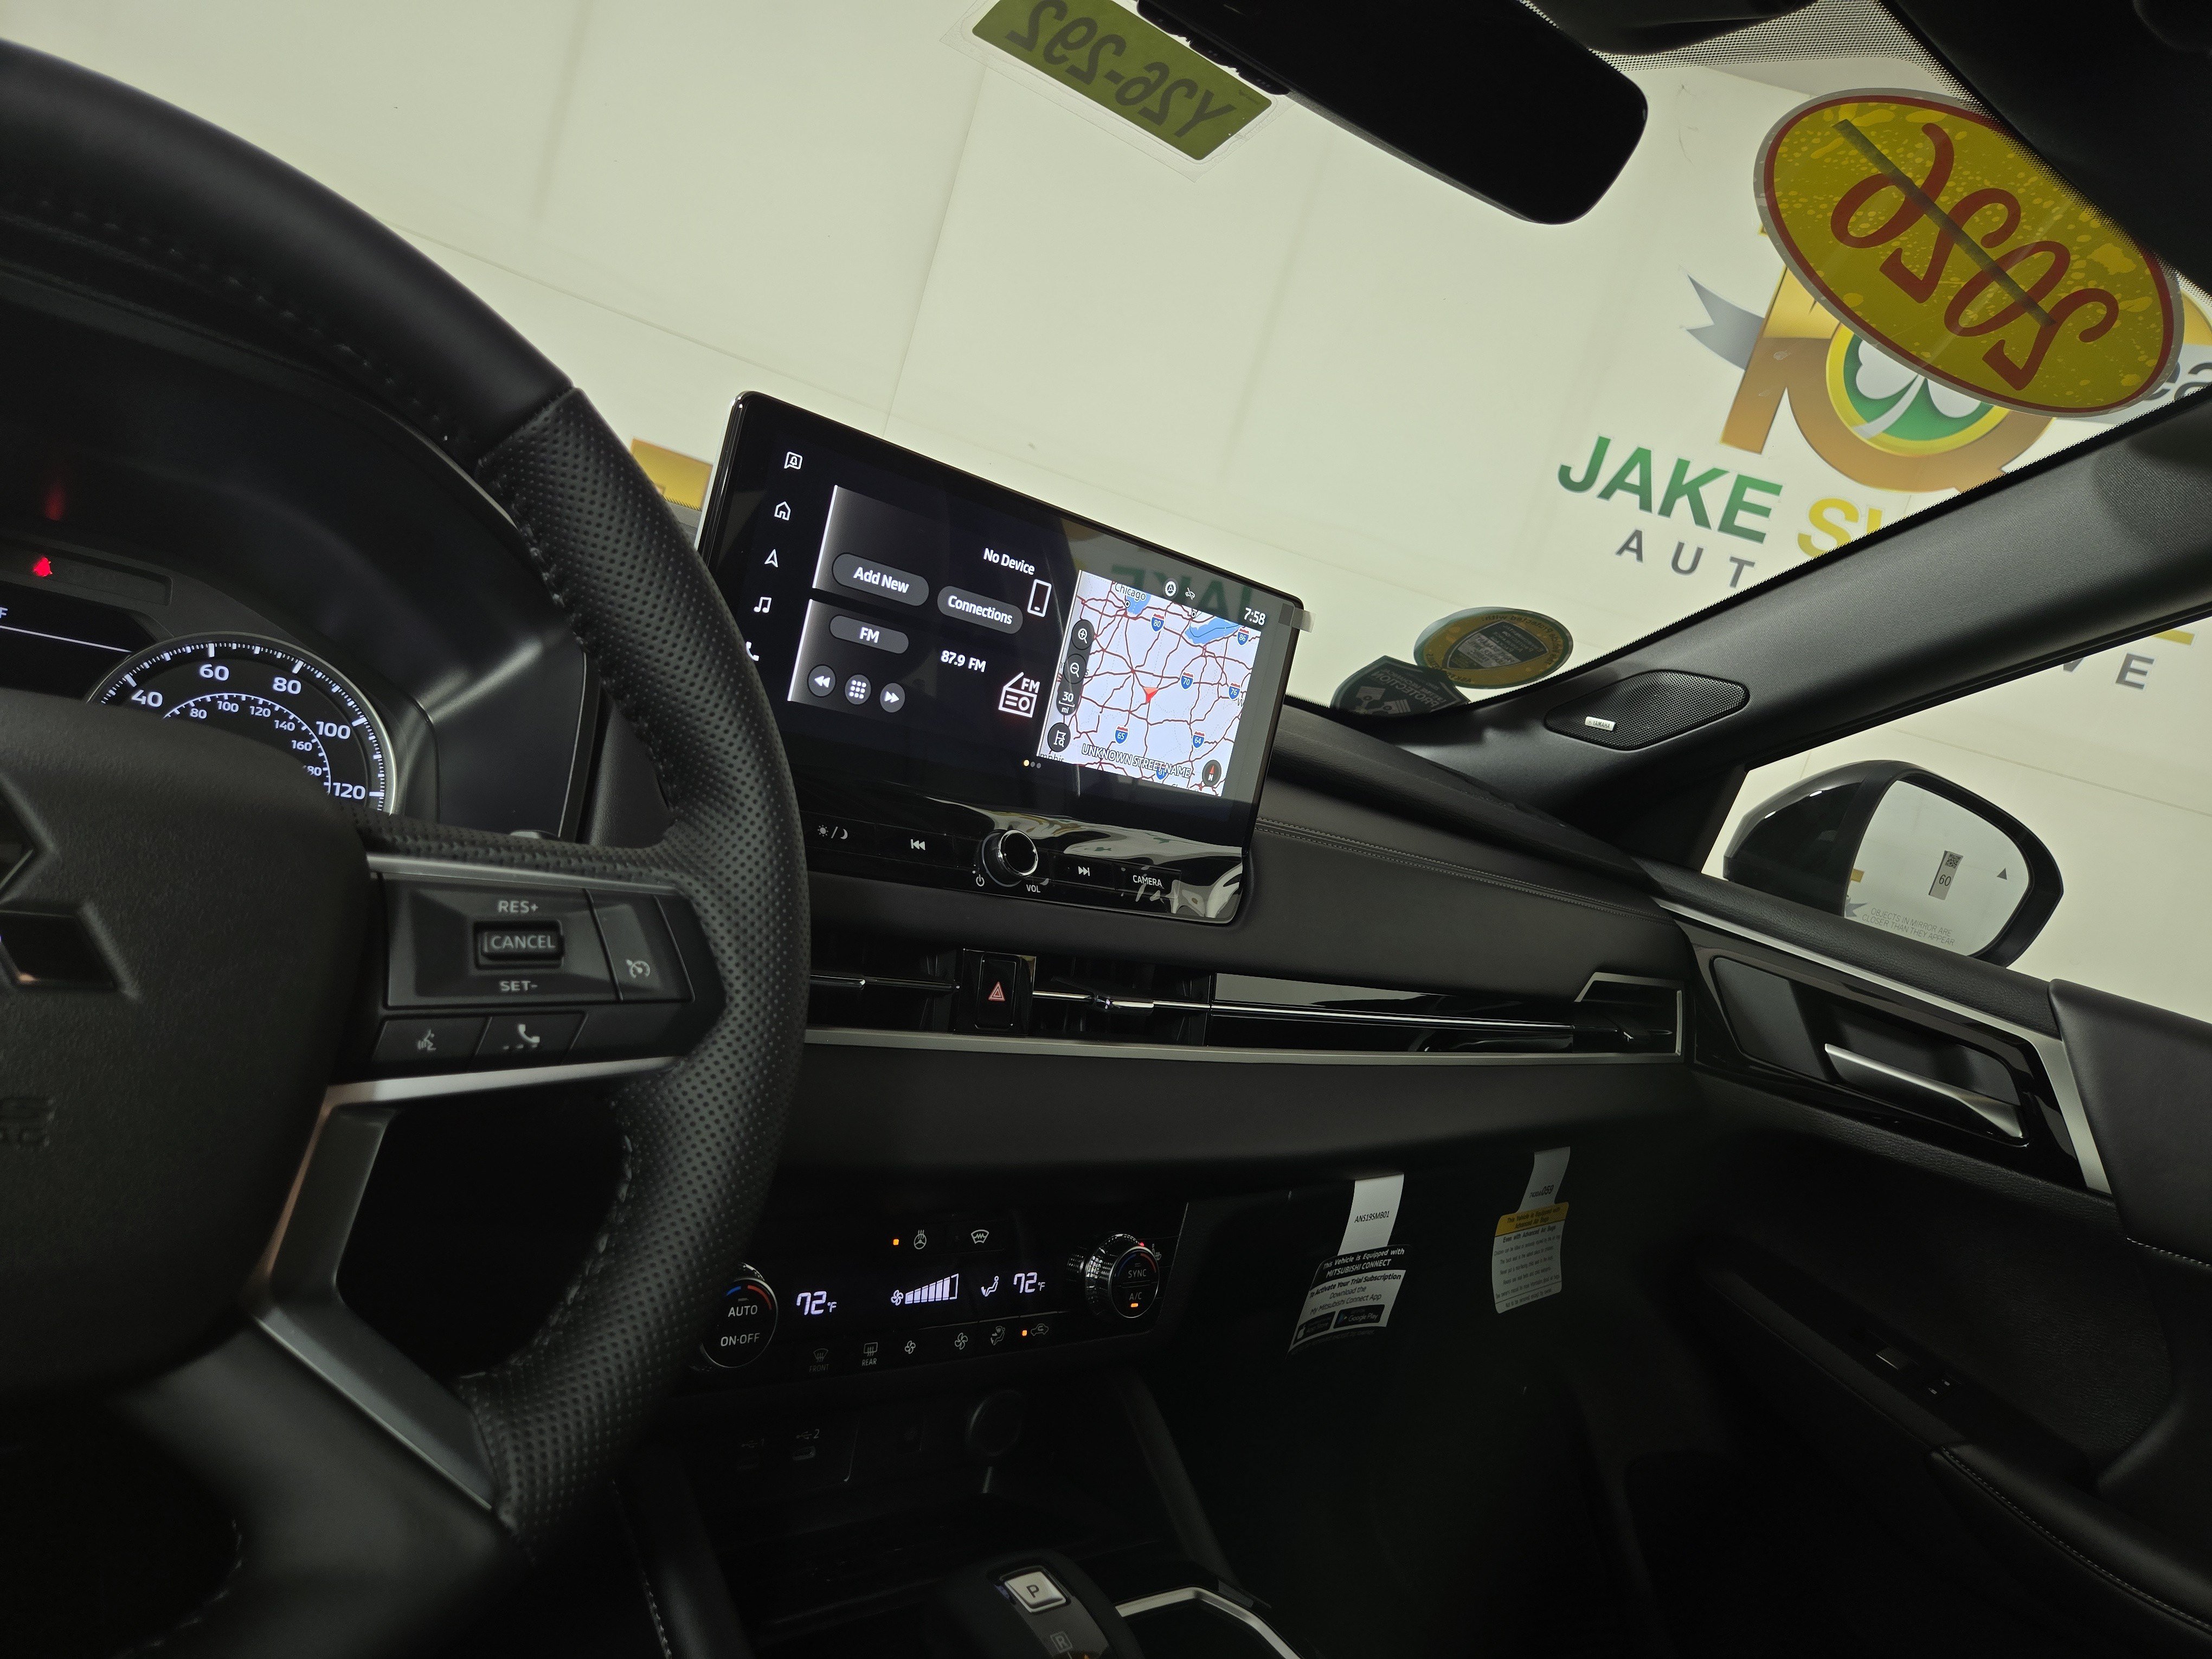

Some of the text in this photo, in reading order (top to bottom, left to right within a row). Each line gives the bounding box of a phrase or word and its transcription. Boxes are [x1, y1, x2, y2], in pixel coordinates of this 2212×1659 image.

[1557, 435, 1784, 545] JAKE
[983, 548, 1036, 575] No Device
[853, 567, 910, 593] Add New
[1115, 582, 1146, 601] Chicago
[948, 595, 1013, 625] Connections
[1244, 607, 1267, 626] 7:58
[1153, 620, 1162, 628] 80
[859, 626, 880, 644] FM
[1238, 634, 1246, 642] 86
[941, 650, 986, 673] 87.9 FM
[199, 664, 230, 681] 60
[272, 677, 301, 695] 80
[1021, 678, 1040, 693] FM
[1182, 678, 1191, 686] 70
[131, 689, 164, 708] 40
[1062, 692, 1074, 703] 30
[1230, 687, 1238, 696] 76
[189, 707, 207, 720] 80
[217, 700, 240, 713] 100
[249, 705, 272, 718] 120
[1061, 706, 1070, 714] mi
[274, 719, 296, 732] 140
[316, 721, 351, 740] 100
[1593, 720, 1610, 729] YAMAHA
[1117, 732, 1125, 741] 65
[1194, 736, 1202, 744] 64
[291, 739, 313, 752] 160
[1082, 743, 1192, 779] UNKNOWN STREET NAME
[332, 782, 366, 800] 120
[1132, 874, 1163, 888] CAMERA
[1938, 873, 1952, 887] 60
[1026, 884, 1041, 894] VOL
[497, 899, 539, 914] RES+
[1870, 907, 1952, 937] OBJECTS IN MIRROR ARE
[1862, 914, 1956, 946] CLOSER THAN THEY APPEAR
[490, 934, 556, 950] CANCEL
[499, 980, 538, 992] SET-
[1322, 1261, 1333, 1270] This
[1334, 1256, 1354, 1266] Vehicle
[1362, 1249, 1389, 1261] Equipped
[1390, 1248, 1405, 1256] with
[1127, 1268, 1147, 1279] SYNC
[1326, 1258, 1392, 1278] MITSUBISHI CONNECT
[1315, 1284, 1336, 1296] Activate
[1336, 1280, 1351, 1290] Your
[1351, 1277, 1362, 1287] Trial
[1362, 1272, 1401, 1284] Subscription
[1129, 1291, 1143, 1301] A/C
[1329, 1288, 1357, 1300] Download
[1345, 1294, 1369, 1304] Connect
[1369, 1293, 1382, 1301] App
[728, 1304, 758, 1318] AUTO
[808, 1363, 829, 1373] FRONT
[861, 1357, 877, 1367] REAR
[813, 1429, 820, 1439] 2
[1026, 1584, 1040, 1598] P
[1055, 1635, 1069, 1649] R
